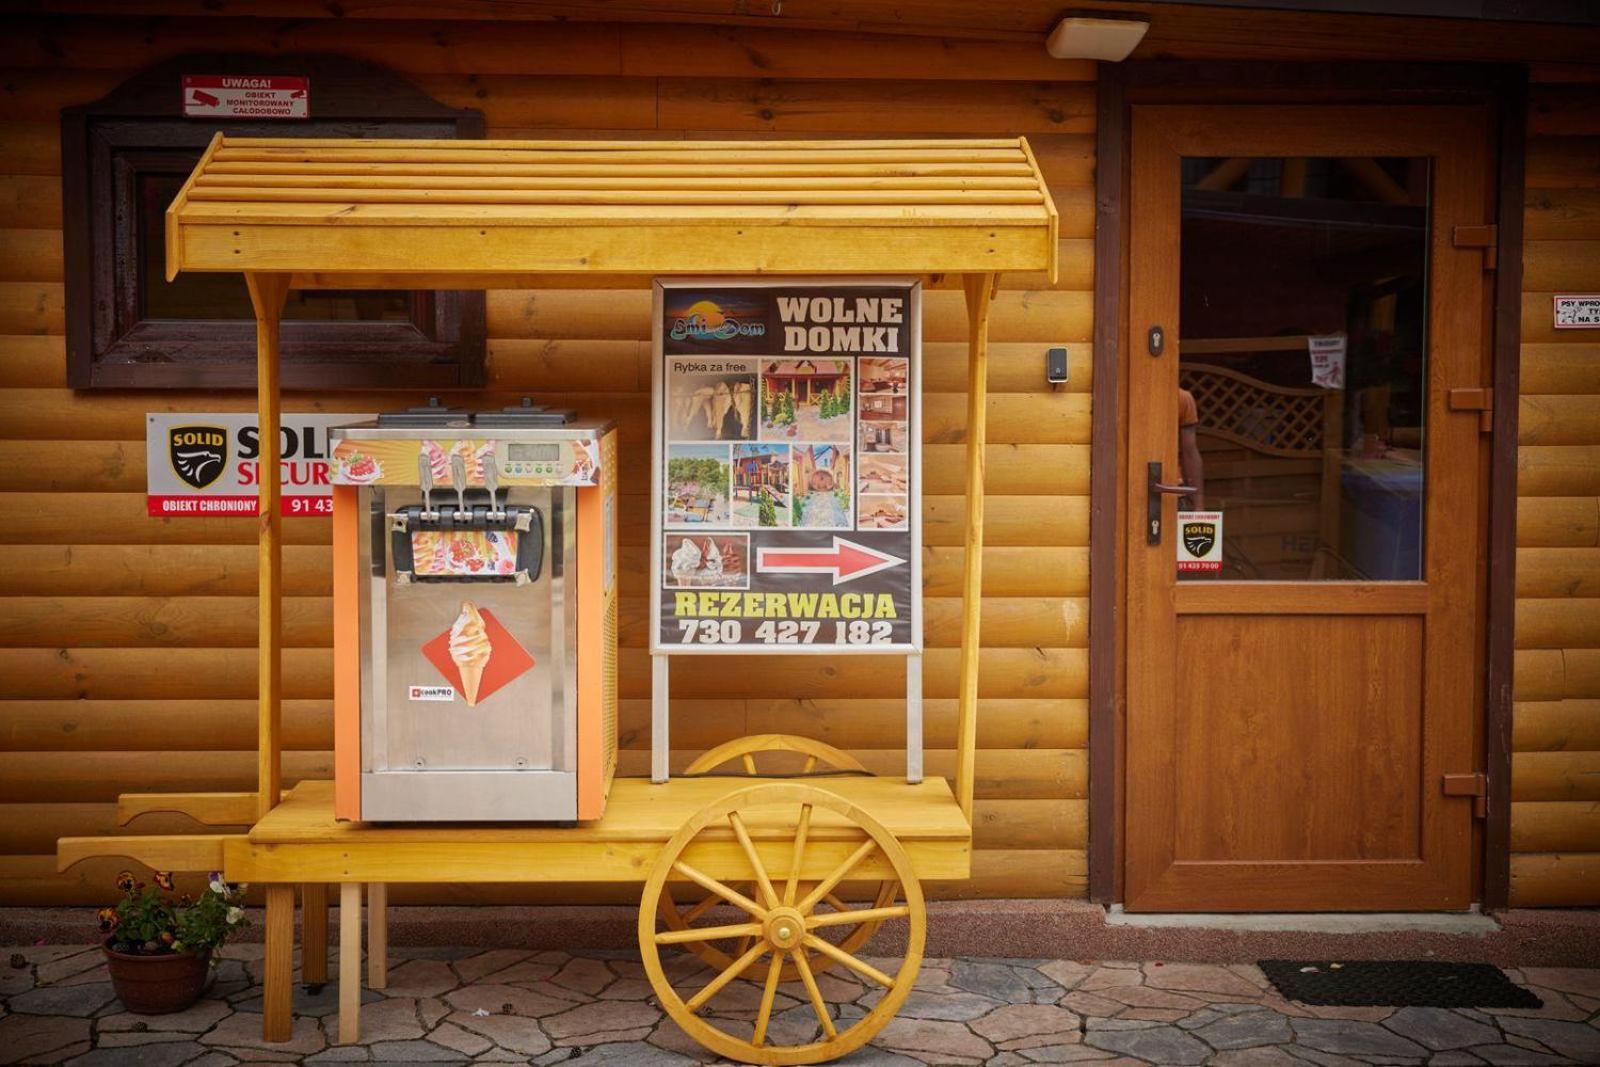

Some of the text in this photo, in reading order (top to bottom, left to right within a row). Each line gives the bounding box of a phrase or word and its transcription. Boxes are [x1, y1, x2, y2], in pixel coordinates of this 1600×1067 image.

[222, 78, 271, 88] UWAGA!
[226, 99, 294, 107] MONITOROWANY
[777, 297, 903, 323] WOLNE
[784, 326, 899, 352] DOMKI
[674, 362, 746, 374] Rybka za free
[173, 432, 224, 446] SOLID
[162, 500, 198, 512] OBIEKT
[200, 500, 257, 512] CHRONIONY
[291, 499, 310, 512] 91
[1185, 526, 1213, 535] SOLID
[675, 592, 897, 618] REZERWACJA
[679, 619, 894, 644] 730 427 182
